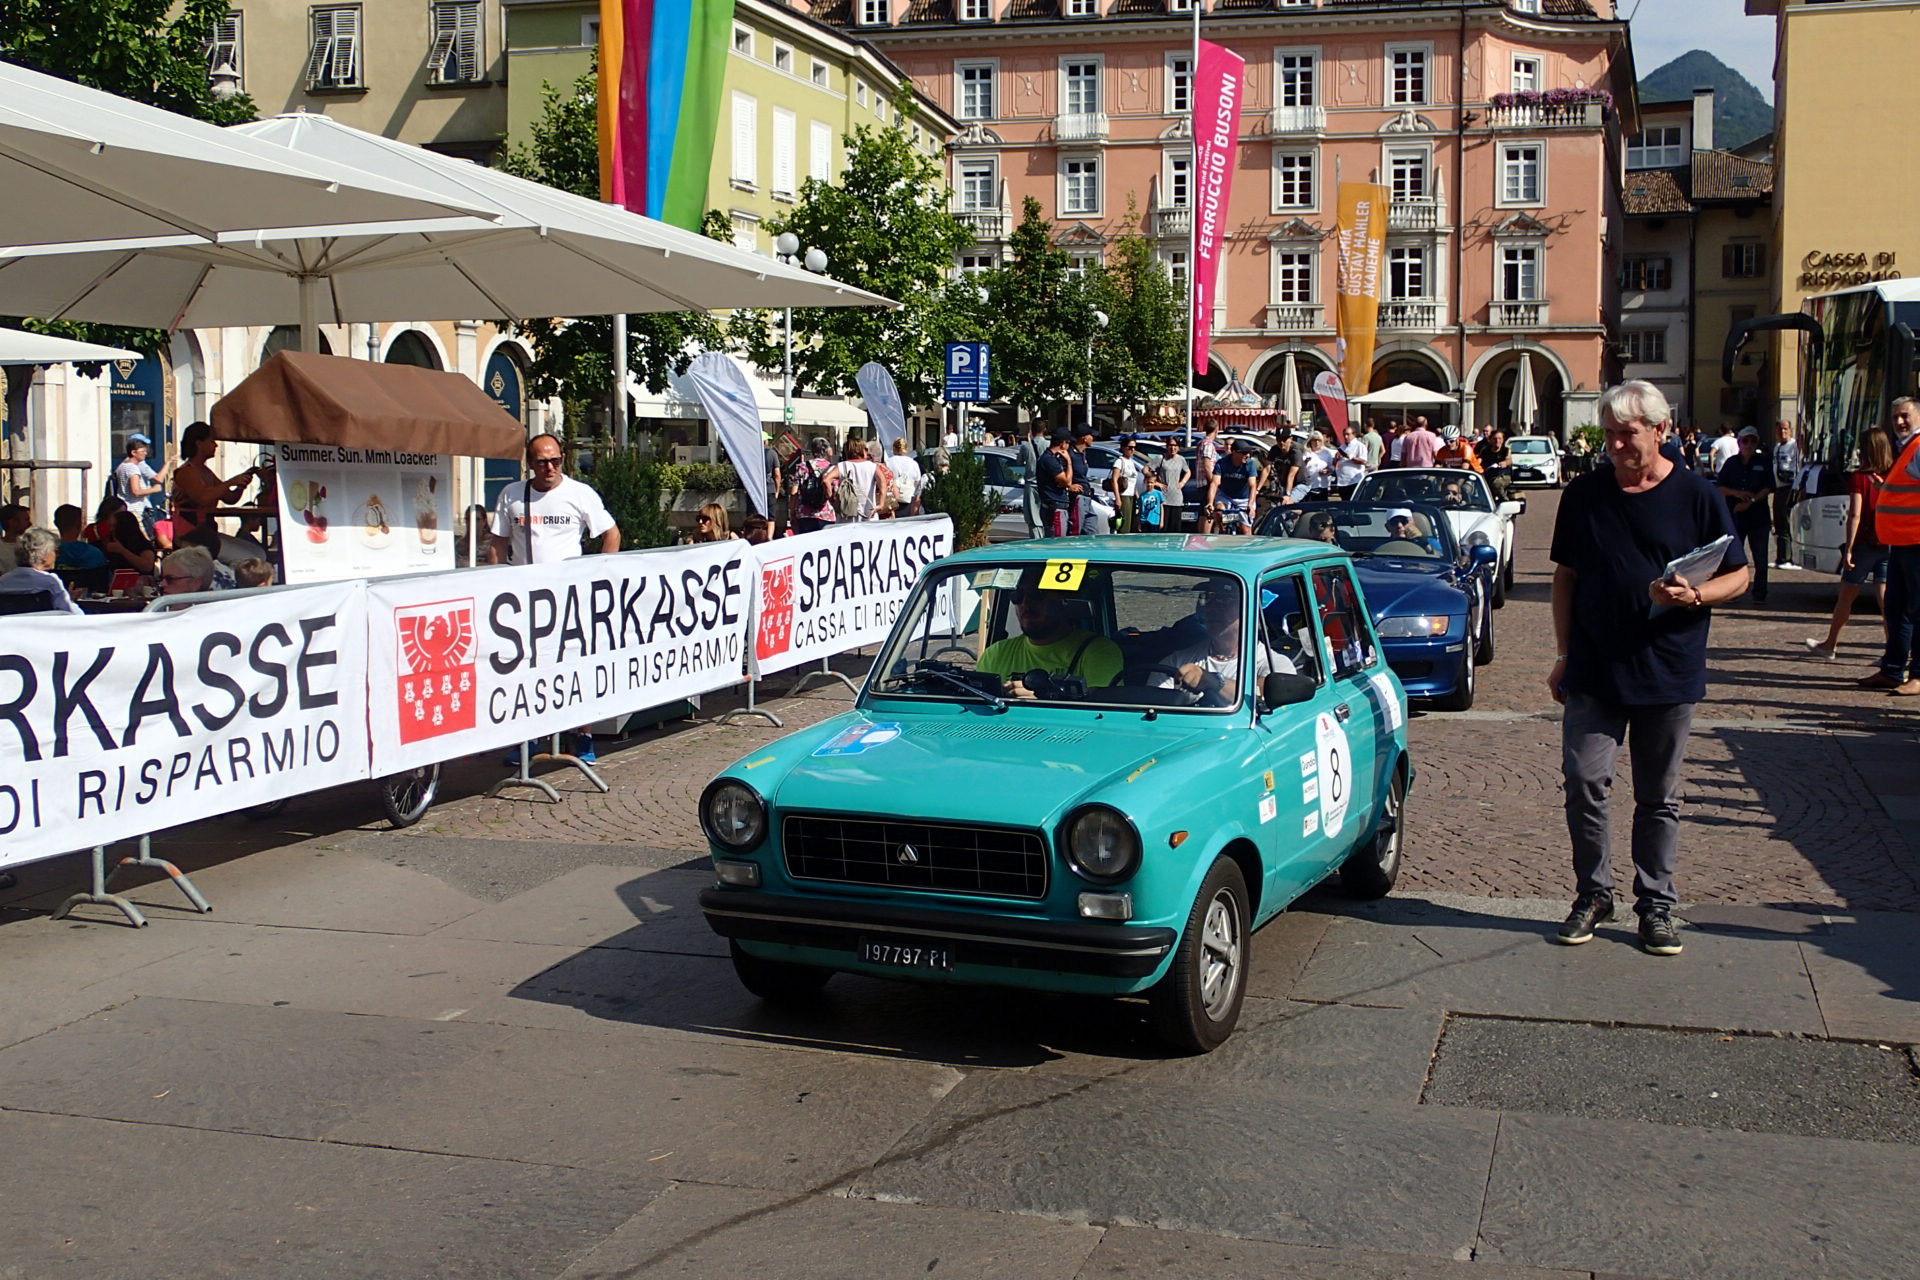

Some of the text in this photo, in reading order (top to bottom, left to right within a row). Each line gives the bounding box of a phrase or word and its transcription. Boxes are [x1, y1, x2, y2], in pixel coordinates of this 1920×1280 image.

[1201, 72, 1237, 259] FERRUCCIO BUSONI
[1203, 140, 1212, 169] Festival
[1347, 201, 1370, 296] GUSTAV MAHLER
[1362, 237, 1380, 298] AKADEMIE
[1879, 251, 1896, 266] DI
[952, 352, 971, 374] P
[980, 352, 987, 374] P
[281, 444, 438, 466] Summer. Sun. Mmh Loacker!
[799, 534, 945, 613] SPARKASSE
[1054, 562, 1074, 583] 8
[488, 558, 743, 676] SPARKASSE
[795, 610, 848, 649] CASSA
[488, 632, 740, 725] CASSA DI RISPARMIO
[77, 719, 341, 820] RISPARMIO
[1330, 748, 1342, 802] 8
[865, 943, 948, 968] 197797 PI
